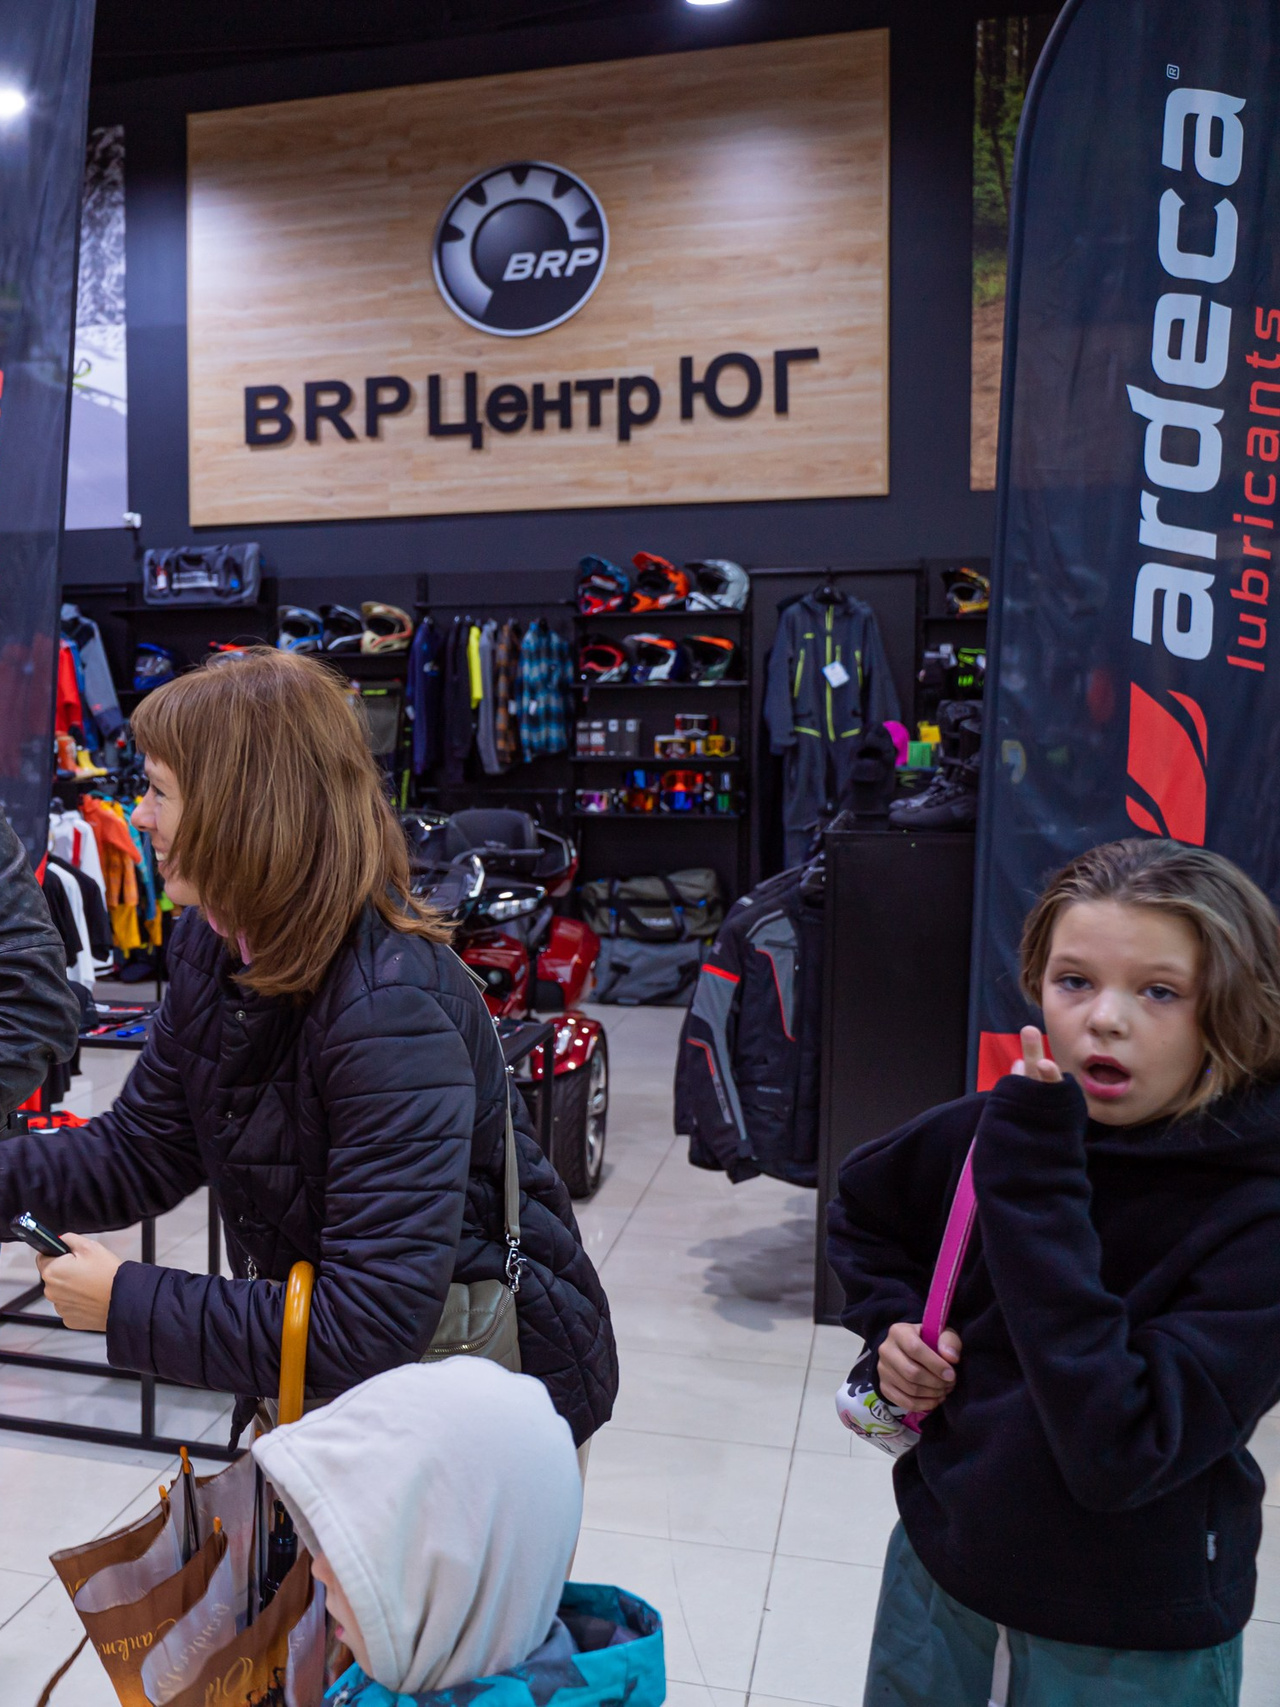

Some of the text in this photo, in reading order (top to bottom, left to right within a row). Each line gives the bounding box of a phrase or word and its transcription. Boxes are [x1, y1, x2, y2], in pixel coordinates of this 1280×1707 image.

[502, 247, 600, 281] BRP
[1125, 87, 1247, 661] ardeca
[427, 371, 661, 449] Центр
[679, 347, 820, 421] ЮГ
[1226, 305, 1280, 672] lubricants
